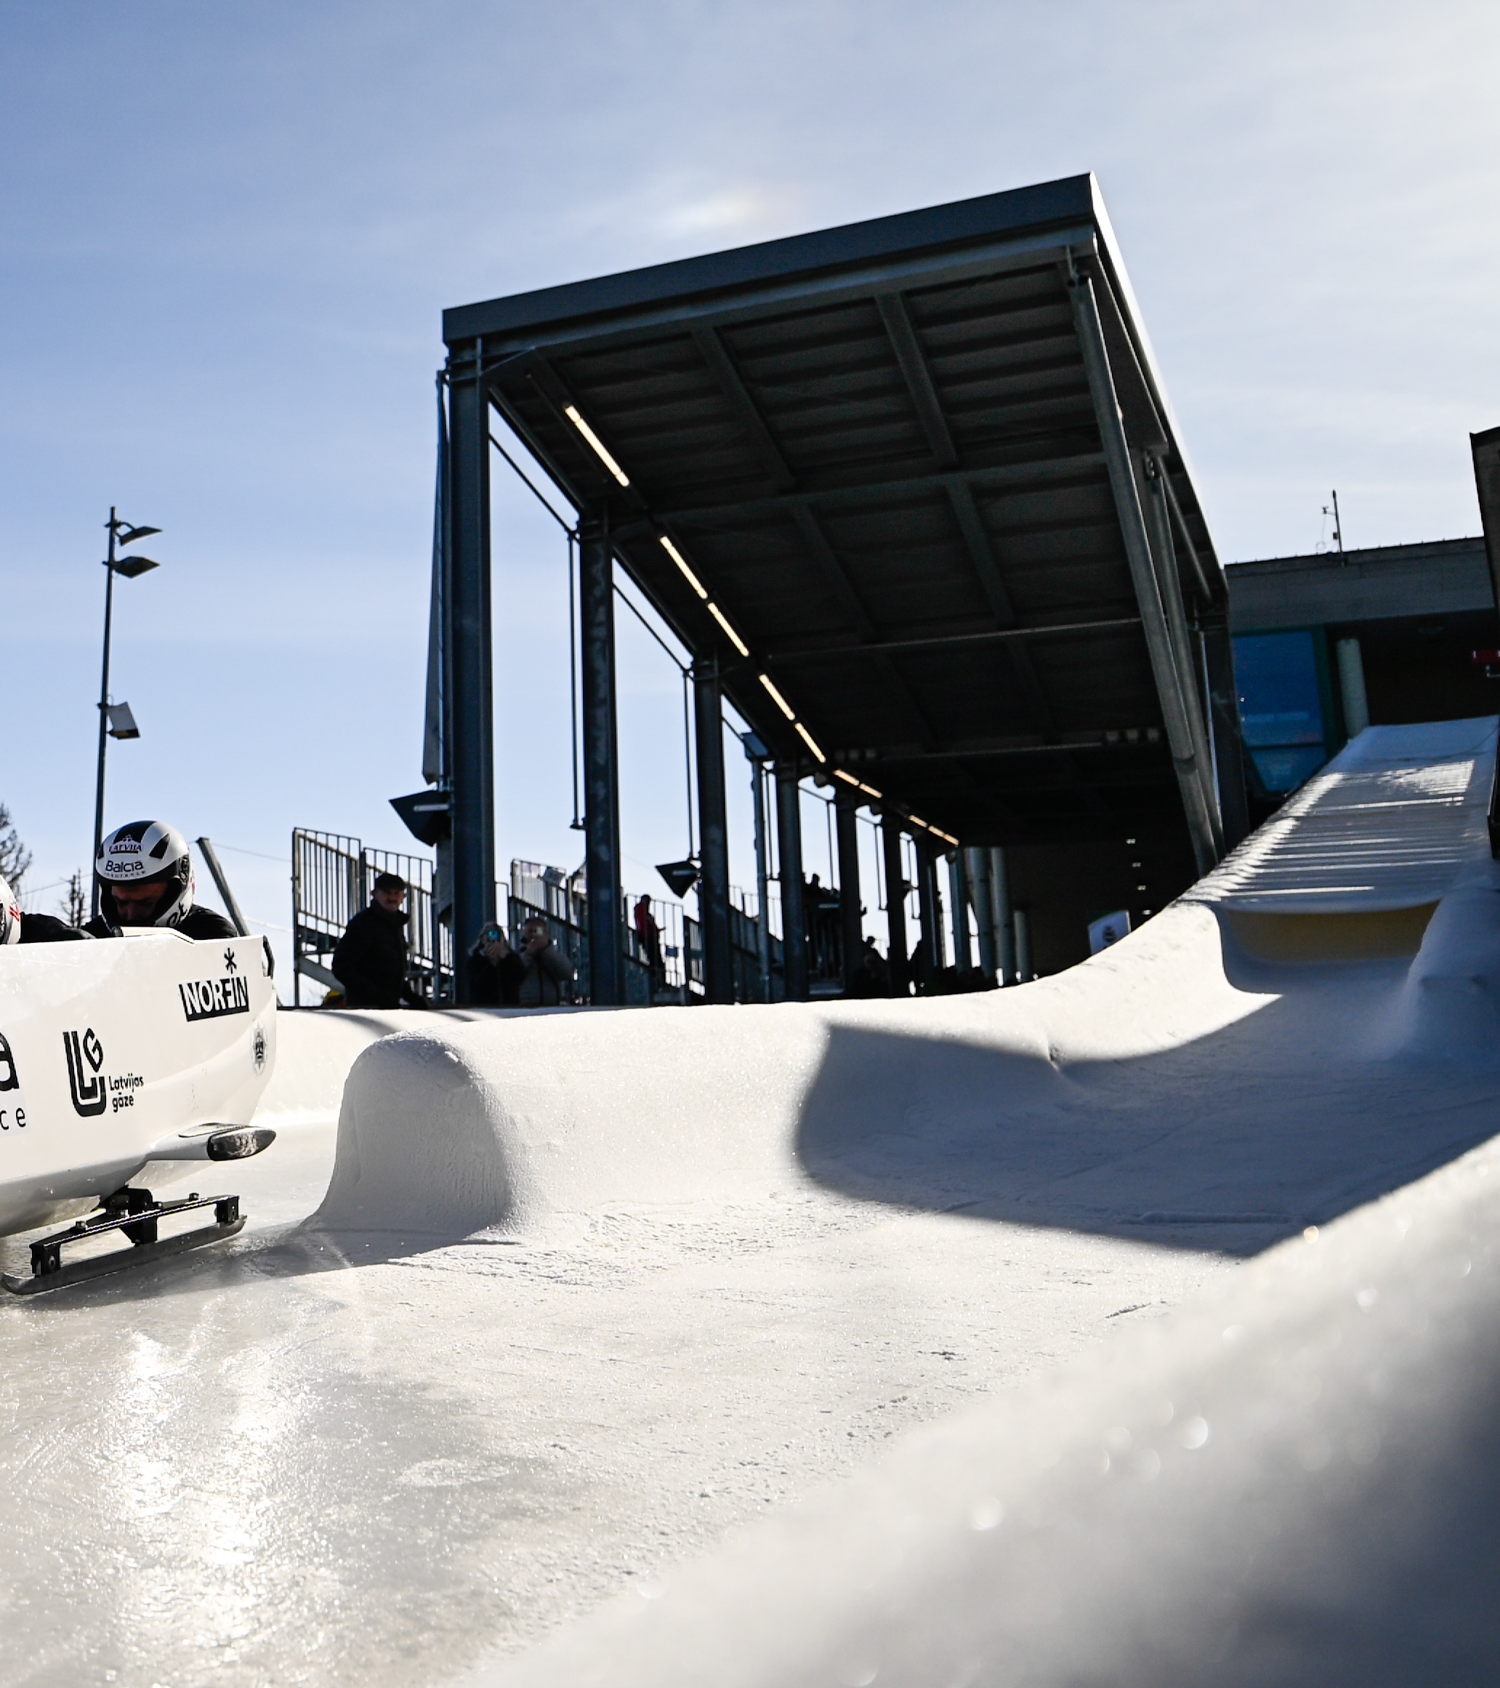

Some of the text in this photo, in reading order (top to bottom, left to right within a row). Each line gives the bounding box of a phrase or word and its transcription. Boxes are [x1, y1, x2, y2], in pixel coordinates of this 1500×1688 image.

[105, 860, 144, 872] Balcia
[179, 976, 249, 1021] NORFIN
[108, 1073, 144, 1092] Latvijas
